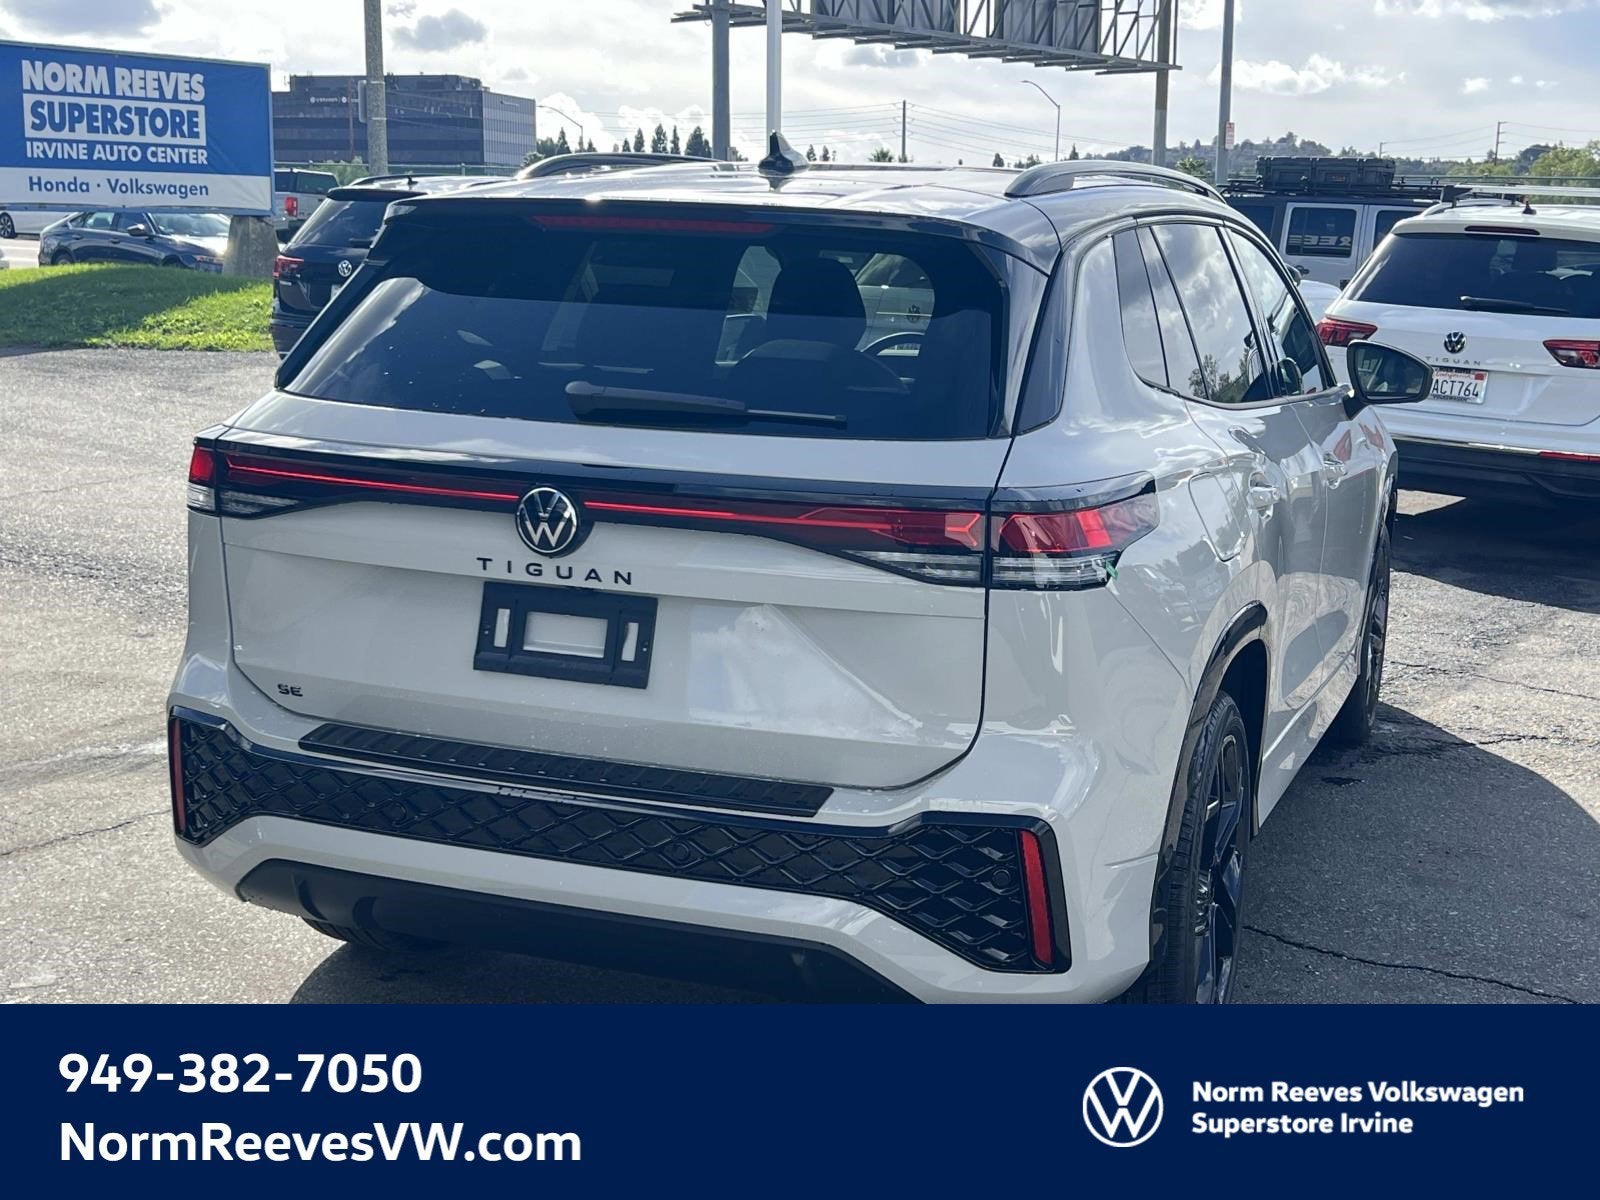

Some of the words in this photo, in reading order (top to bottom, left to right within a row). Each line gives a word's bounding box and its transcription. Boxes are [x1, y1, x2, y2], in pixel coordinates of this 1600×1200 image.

[22, 59, 110, 96] NORM
[114, 67, 206, 102] REEVES
[30, 100, 200, 139] SUPERSTORE
[26, 141, 88, 160] IRVINE
[93, 145, 142, 162] AUTO
[146, 147, 208, 165] CENTER
[28, 176, 90, 193] Honda
[107, 178, 209, 199] Volkswagen
[1425, 356, 1481, 366] TIGUAN
[1431, 379, 1479, 397] ACT764
[476, 557, 632, 585] TIGUAN
[277, 683, 304, 697] SE
